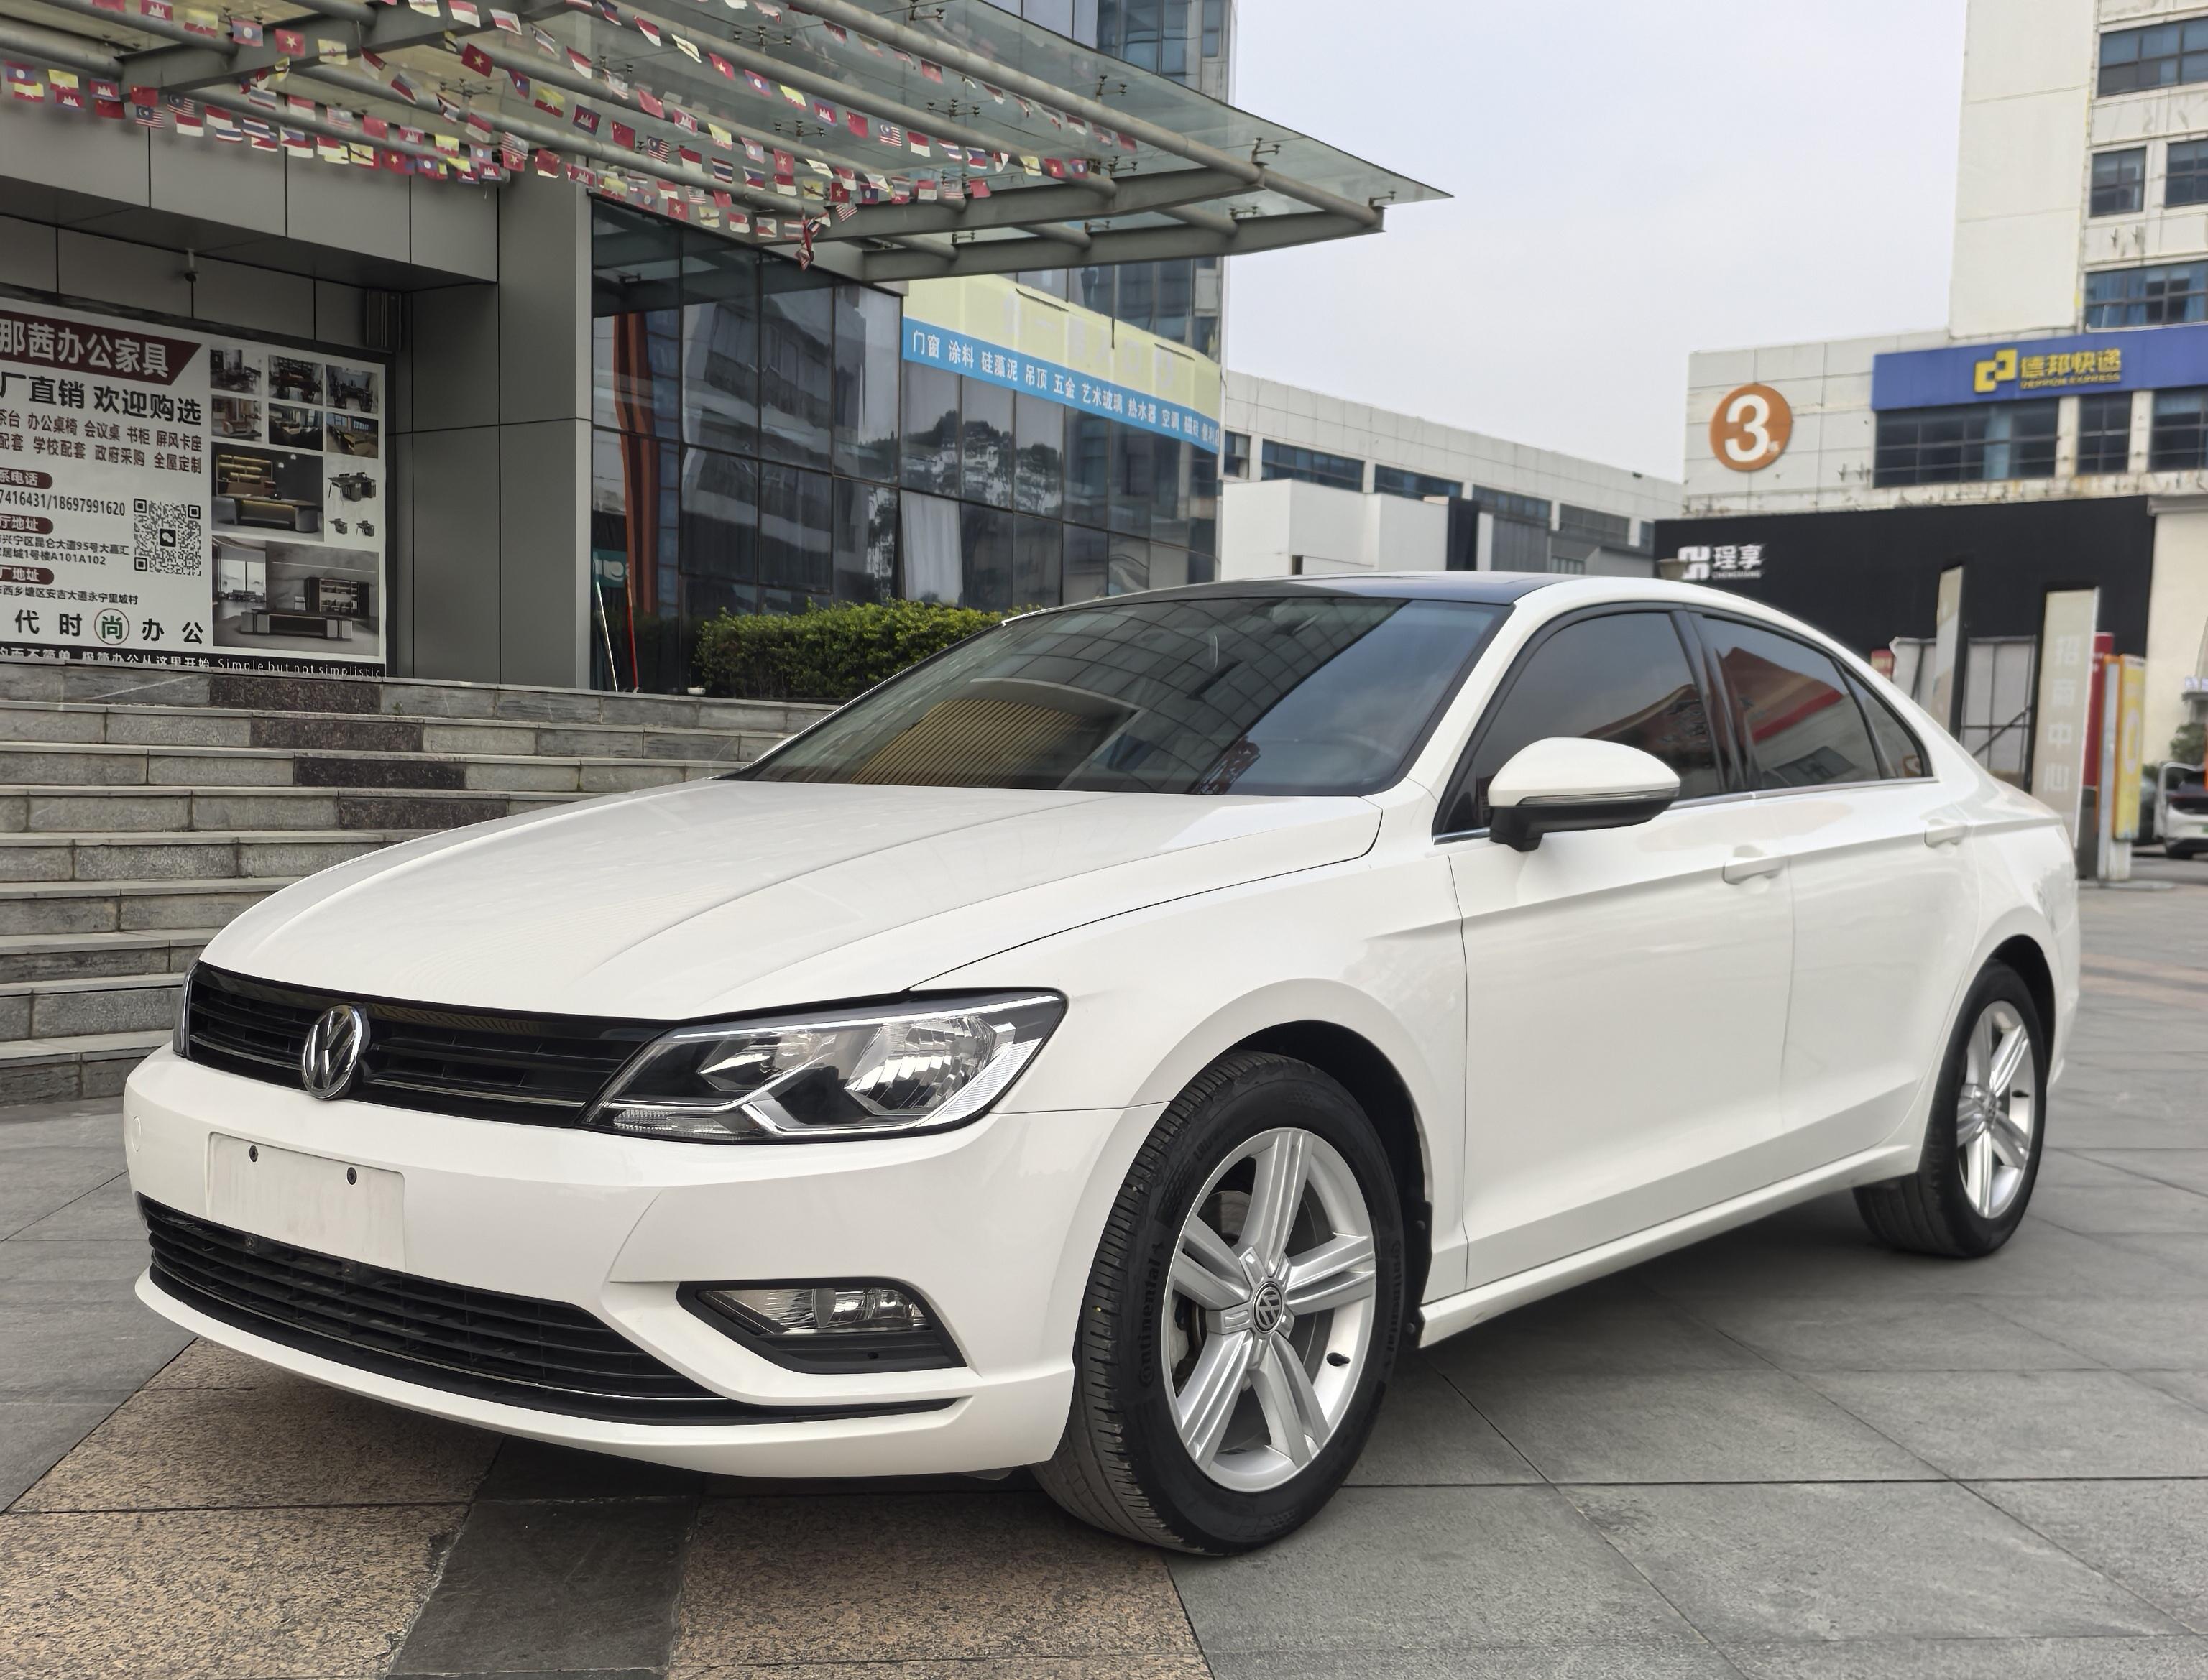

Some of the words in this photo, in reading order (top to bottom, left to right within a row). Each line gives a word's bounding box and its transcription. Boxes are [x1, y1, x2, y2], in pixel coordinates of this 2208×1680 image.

[0, 318, 169, 378] 那茜办公家具
[913, 329, 940, 359] 门窗
[948, 339, 974, 369] 涂料
[981, 350, 1018, 382] 硅藻泥
[1025, 364, 1048, 391] 吊顶
[1053, 373, 1075, 399] 五金
[1082, 382, 1123, 415] 艺术玻璃
[1128, 397, 1156, 424] 热水器
[0, 371, 85, 410] 厂直销
[93, 386, 202, 426] 欢迎购选
[27, 412, 78, 436] 办公桌椅
[84, 420, 121, 442] 会议桌
[126, 425, 150, 446] 书柜
[156, 430, 203, 452] 屏风卡座
[1724, 394, 1770, 462] 3
[33, 435, 86, 460] 学校配套
[94, 444, 145, 467] 政府采购
[154, 451, 202, 474] 全屋定制
[0, 534, 130, 555] 兴宁区昆仑大道95号大嘉汇
[0, 547, 106, 566] 居城1号楼A101A102
[0, 585, 138, 605] 西乡塘区安吉大道永宁里坡村
[218, 659, 264, 671] Simple
